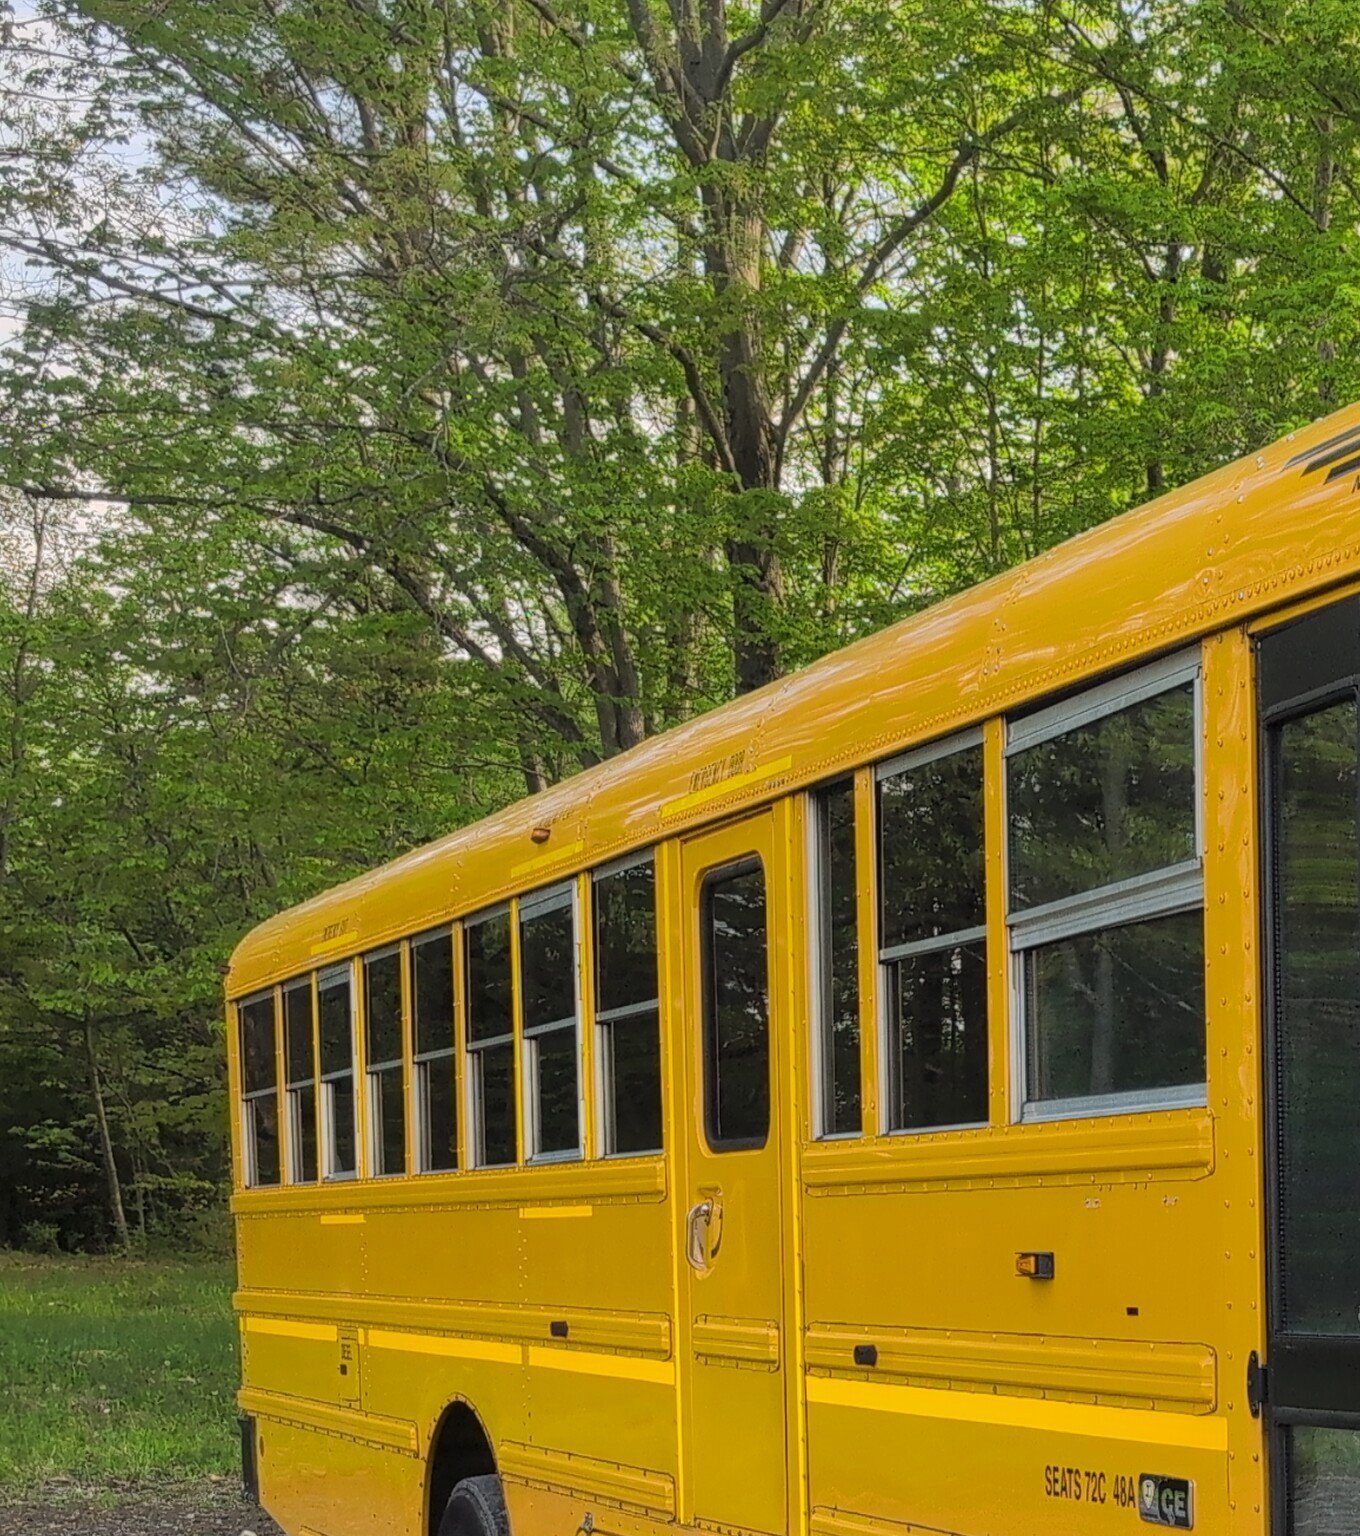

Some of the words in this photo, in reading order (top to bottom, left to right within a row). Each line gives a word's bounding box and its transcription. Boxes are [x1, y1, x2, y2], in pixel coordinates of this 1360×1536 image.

[1044, 1464, 1082, 1500] SEATS
[1084, 1470, 1107, 1505] 72C
[1113, 1473, 1137, 1509] 48A
